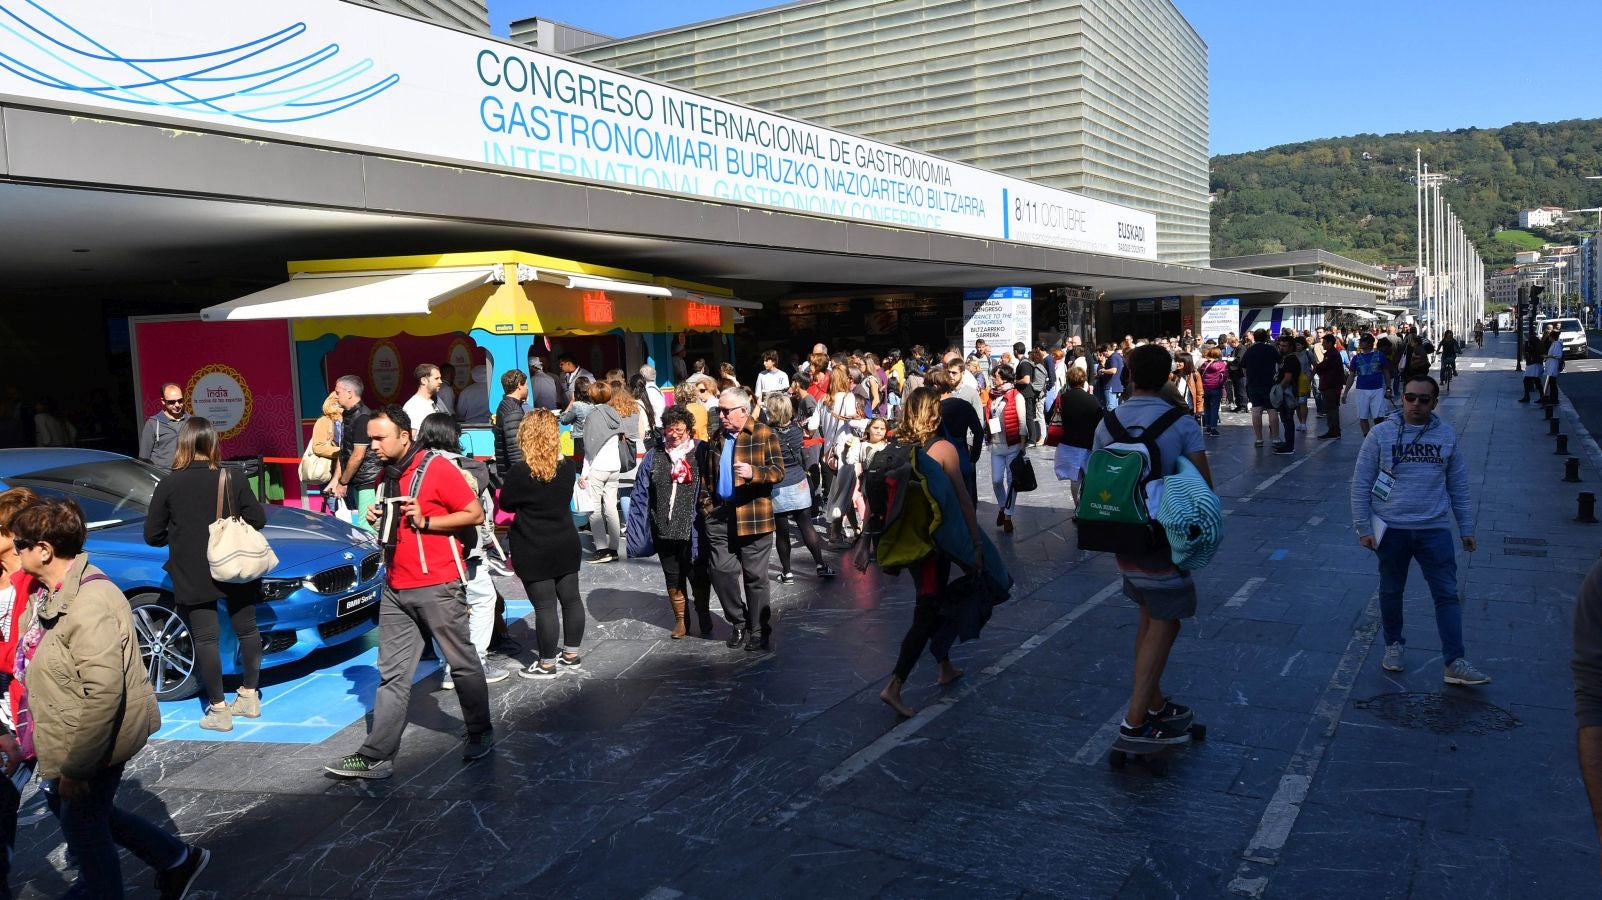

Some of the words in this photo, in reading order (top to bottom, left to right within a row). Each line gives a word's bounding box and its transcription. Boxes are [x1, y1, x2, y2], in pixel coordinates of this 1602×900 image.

[477, 49, 653, 120] CONGRESO
[663, 95, 825, 159] INTERNACIONAL
[830, 138, 850, 165] DE
[855, 144, 952, 187] GASTRONOMIA
[480, 96, 718, 172] GASTRONOMIARI
[726, 146, 819, 189] BURUZKO
[824, 167, 924, 207] NAZIOARTEKO
[928, 188, 986, 218] BILTZARRA
[1015, 197, 1037, 224] 8/11
[1041, 202, 1087, 233] OCTUBRE
[1118, 221, 1146, 243] EUSKADI
[1391, 443, 1442, 458] HARRY
[347, 598, 361, 609] BMW
